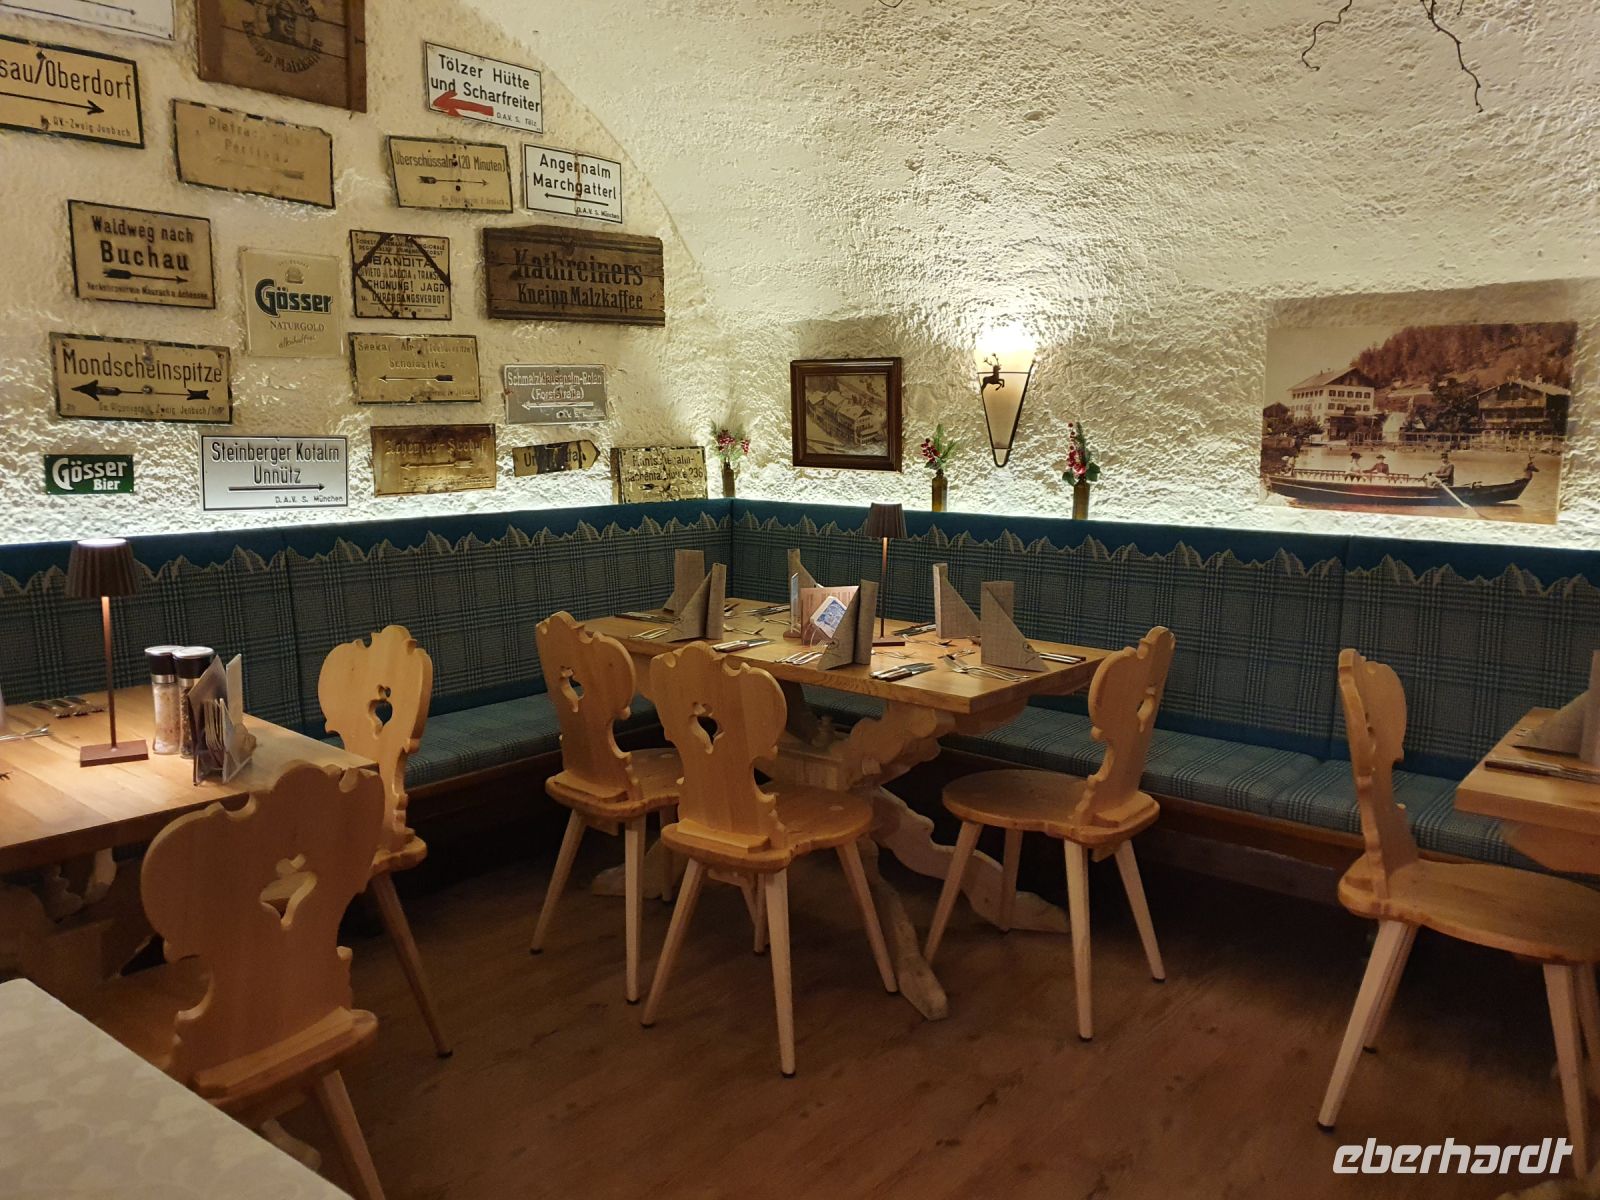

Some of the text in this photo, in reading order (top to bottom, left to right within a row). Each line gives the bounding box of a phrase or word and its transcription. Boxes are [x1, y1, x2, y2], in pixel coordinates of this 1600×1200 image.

[438, 53, 530, 90] Tölzer Hütte
[430, 77, 541, 112] und Scharfreiter
[474, 155, 506, 173] Minuten)
[540, 153, 611, 179] Angernalm
[533, 172, 617, 200] Marchgatterl
[91, 215, 194, 243] Waldweg nach
[100, 240, 190, 271] Buchau
[373, 255, 432, 268] BANDITA
[513, 247, 644, 286] Kathreiners
[255, 278, 333, 318] Gösser
[517, 282, 644, 313] Kneipp Malzkaffee
[62, 348, 223, 389] Mondscheinspitze
[211, 441, 339, 465] Steinberger Kotalm
[52, 457, 128, 490] Gösser
[93, 478, 120, 491] Bier
[253, 464, 302, 485] Unnütz
[313, 494, 343, 503] München
